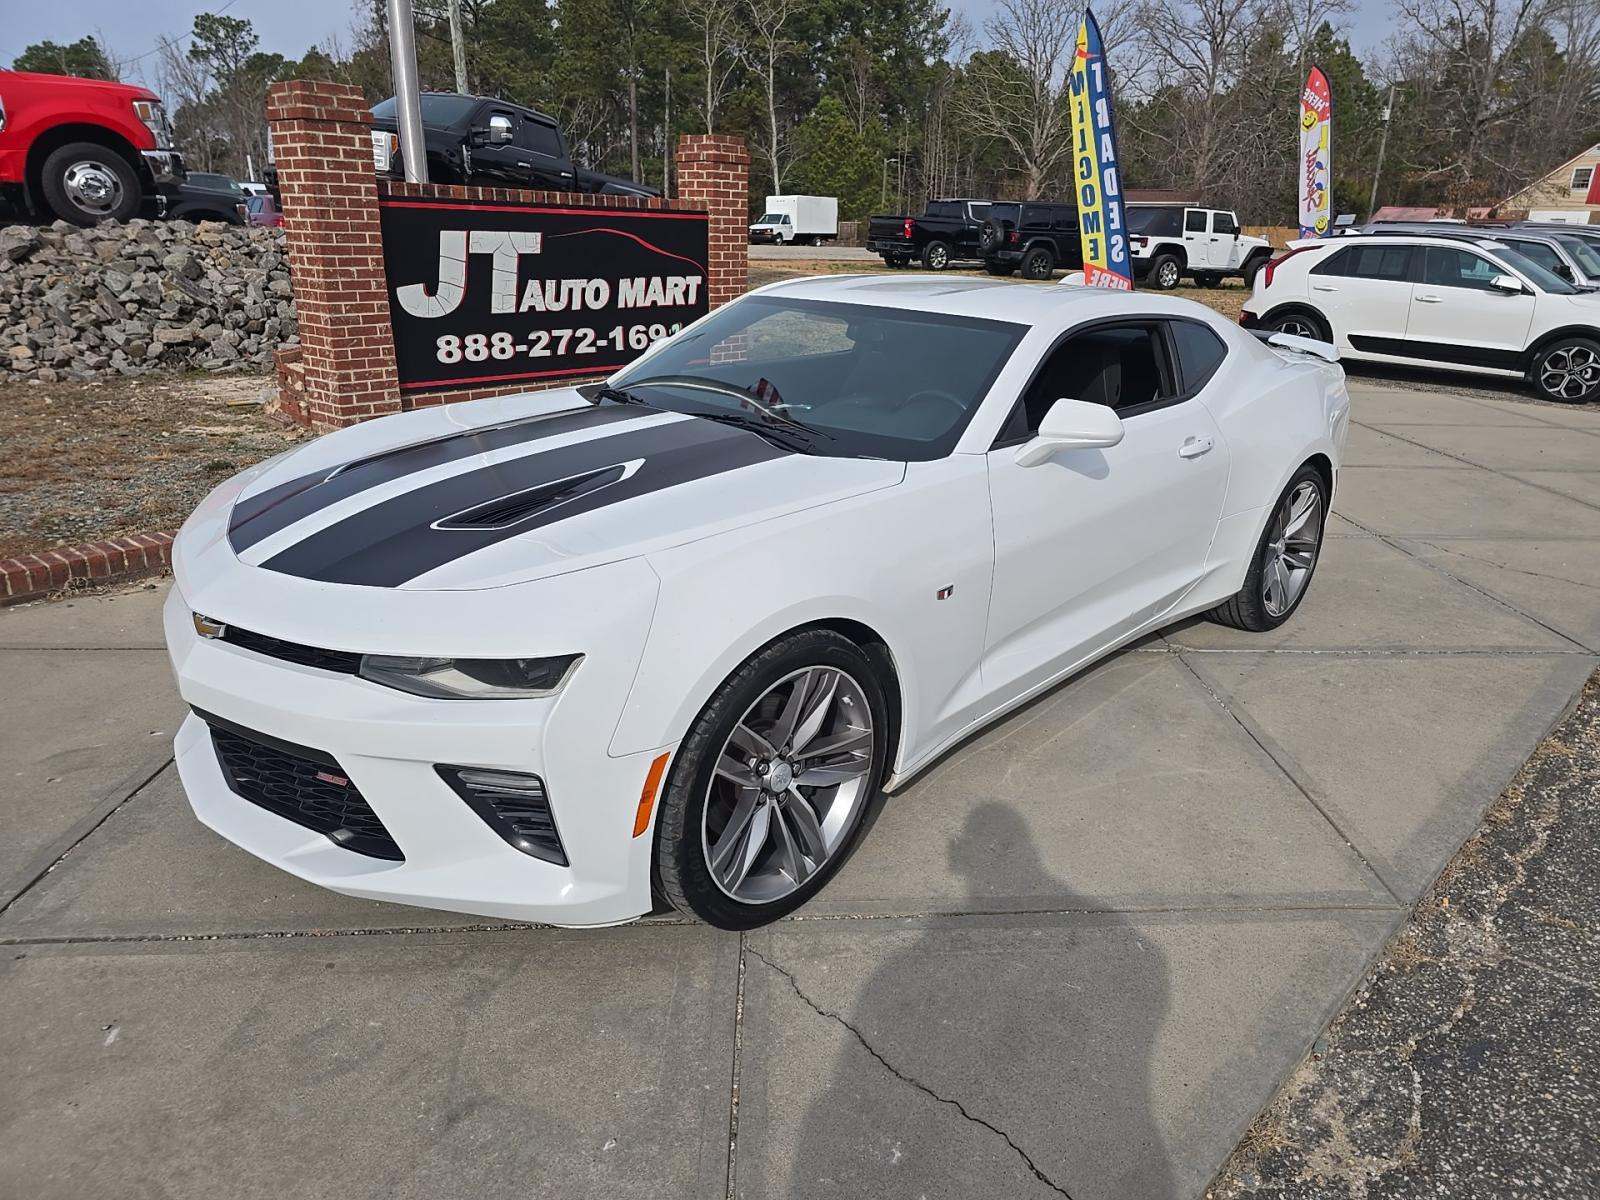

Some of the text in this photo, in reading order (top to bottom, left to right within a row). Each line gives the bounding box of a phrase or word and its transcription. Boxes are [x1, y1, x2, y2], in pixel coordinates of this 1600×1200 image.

[396, 230, 702, 318] JT AUTO MART
